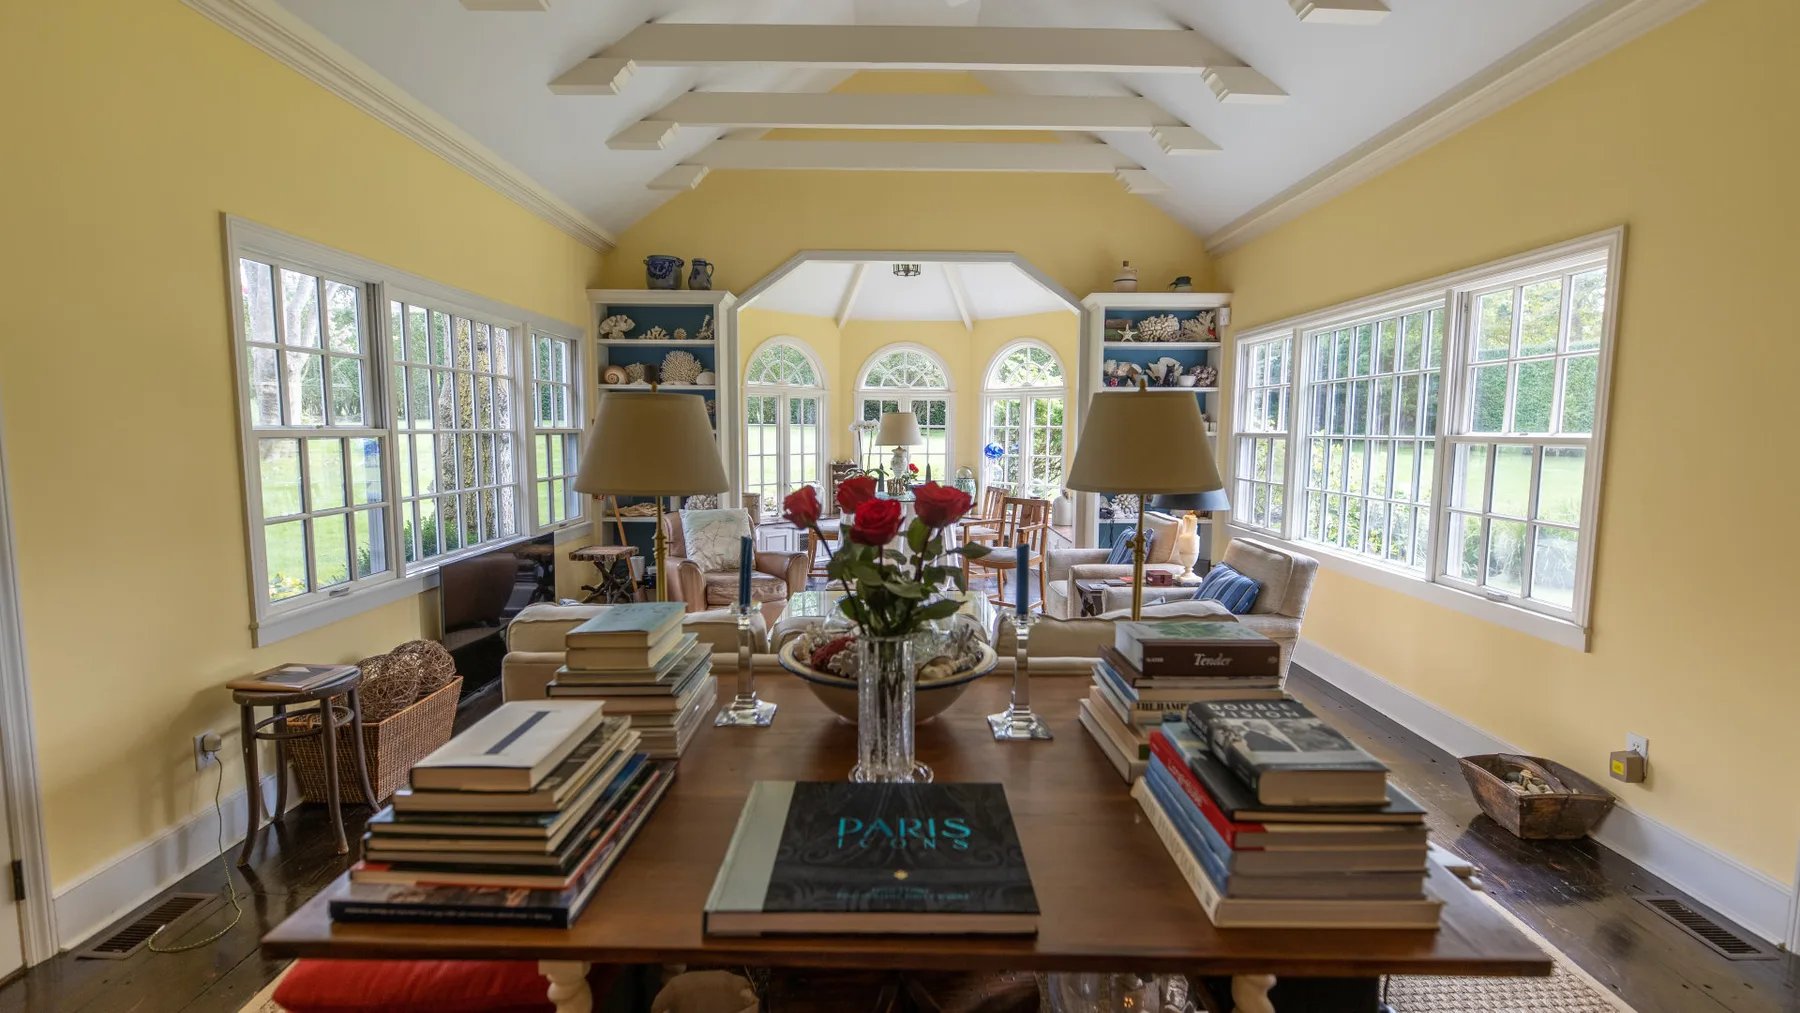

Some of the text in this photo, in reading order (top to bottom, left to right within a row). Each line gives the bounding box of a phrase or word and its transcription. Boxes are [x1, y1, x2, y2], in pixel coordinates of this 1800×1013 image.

[1194, 653, 1233, 666] Tender
[1136, 702, 1188, 711] THE HAMP
[1207, 703, 1291, 711] DOUBLE
[1213, 710, 1300, 718] VISION
[837, 817, 972, 838] PARIS
[837, 837, 970, 850] ICONS
